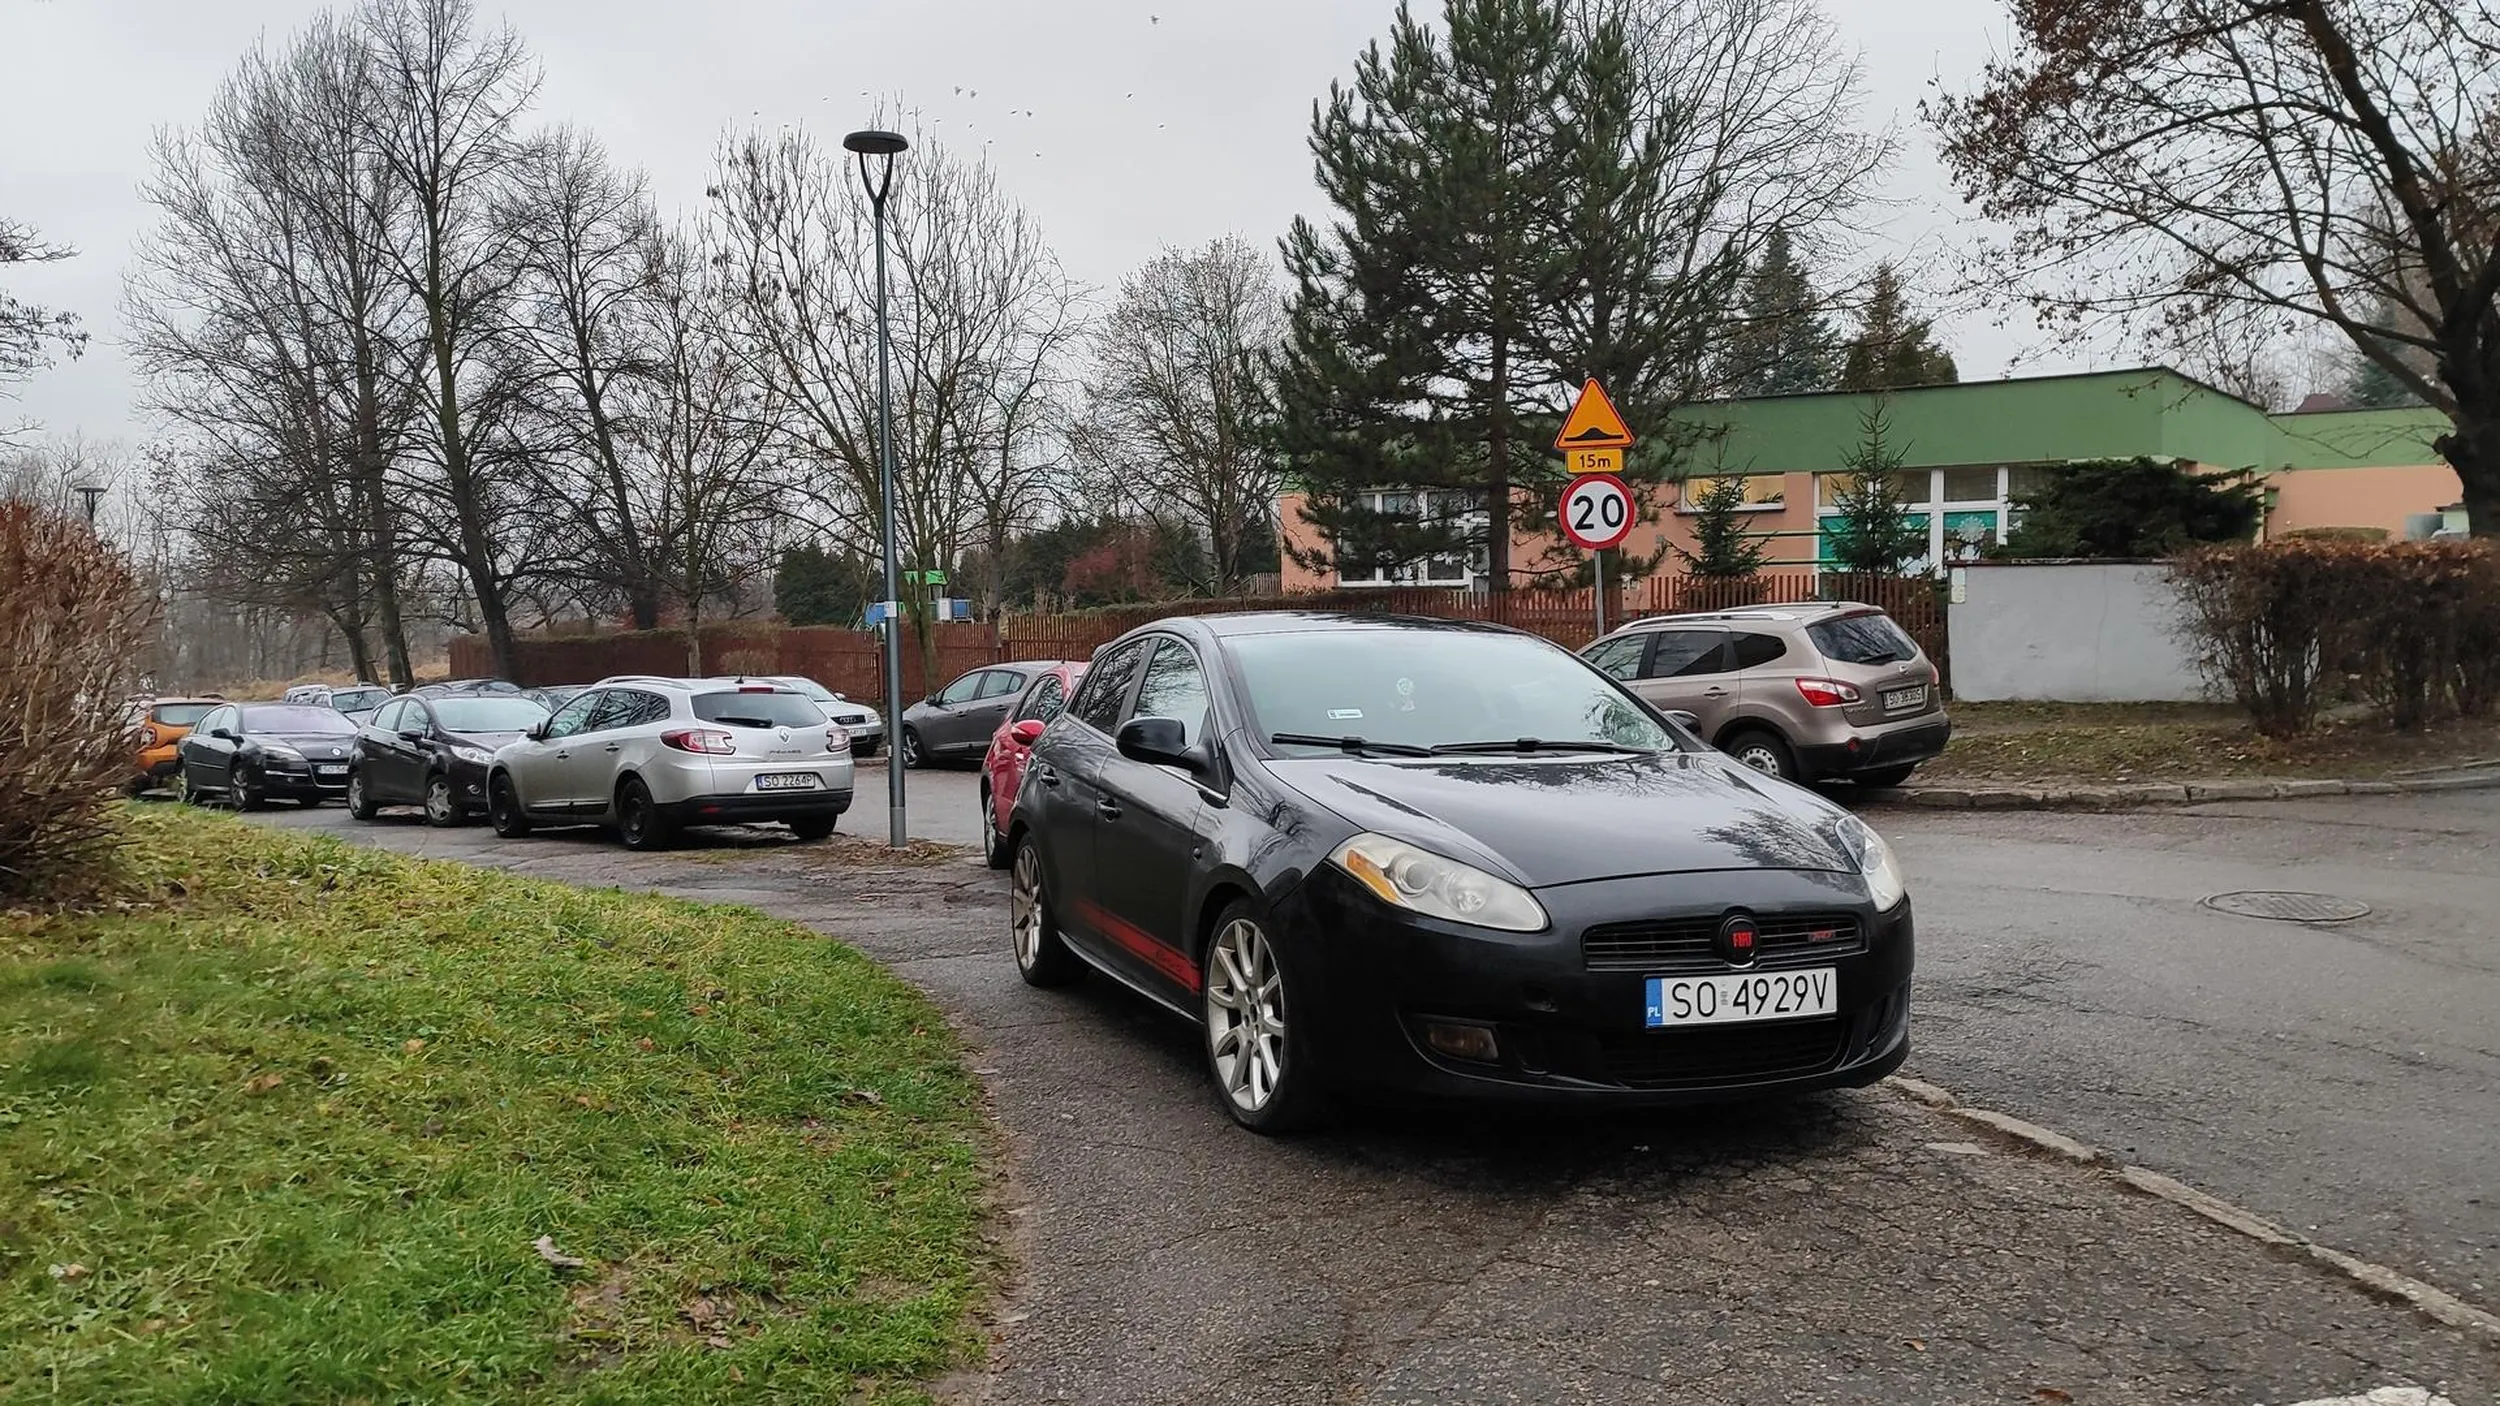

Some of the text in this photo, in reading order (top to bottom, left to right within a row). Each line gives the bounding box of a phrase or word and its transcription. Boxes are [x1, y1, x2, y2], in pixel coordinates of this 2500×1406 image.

[1579, 454, 1611, 468] 15m
[1573, 493, 1625, 530] 20
[1732, 931, 1753, 948] FIAT
[1671, 972, 1828, 1019] SO 4929V
[1647, 1007, 1661, 1018] PL
